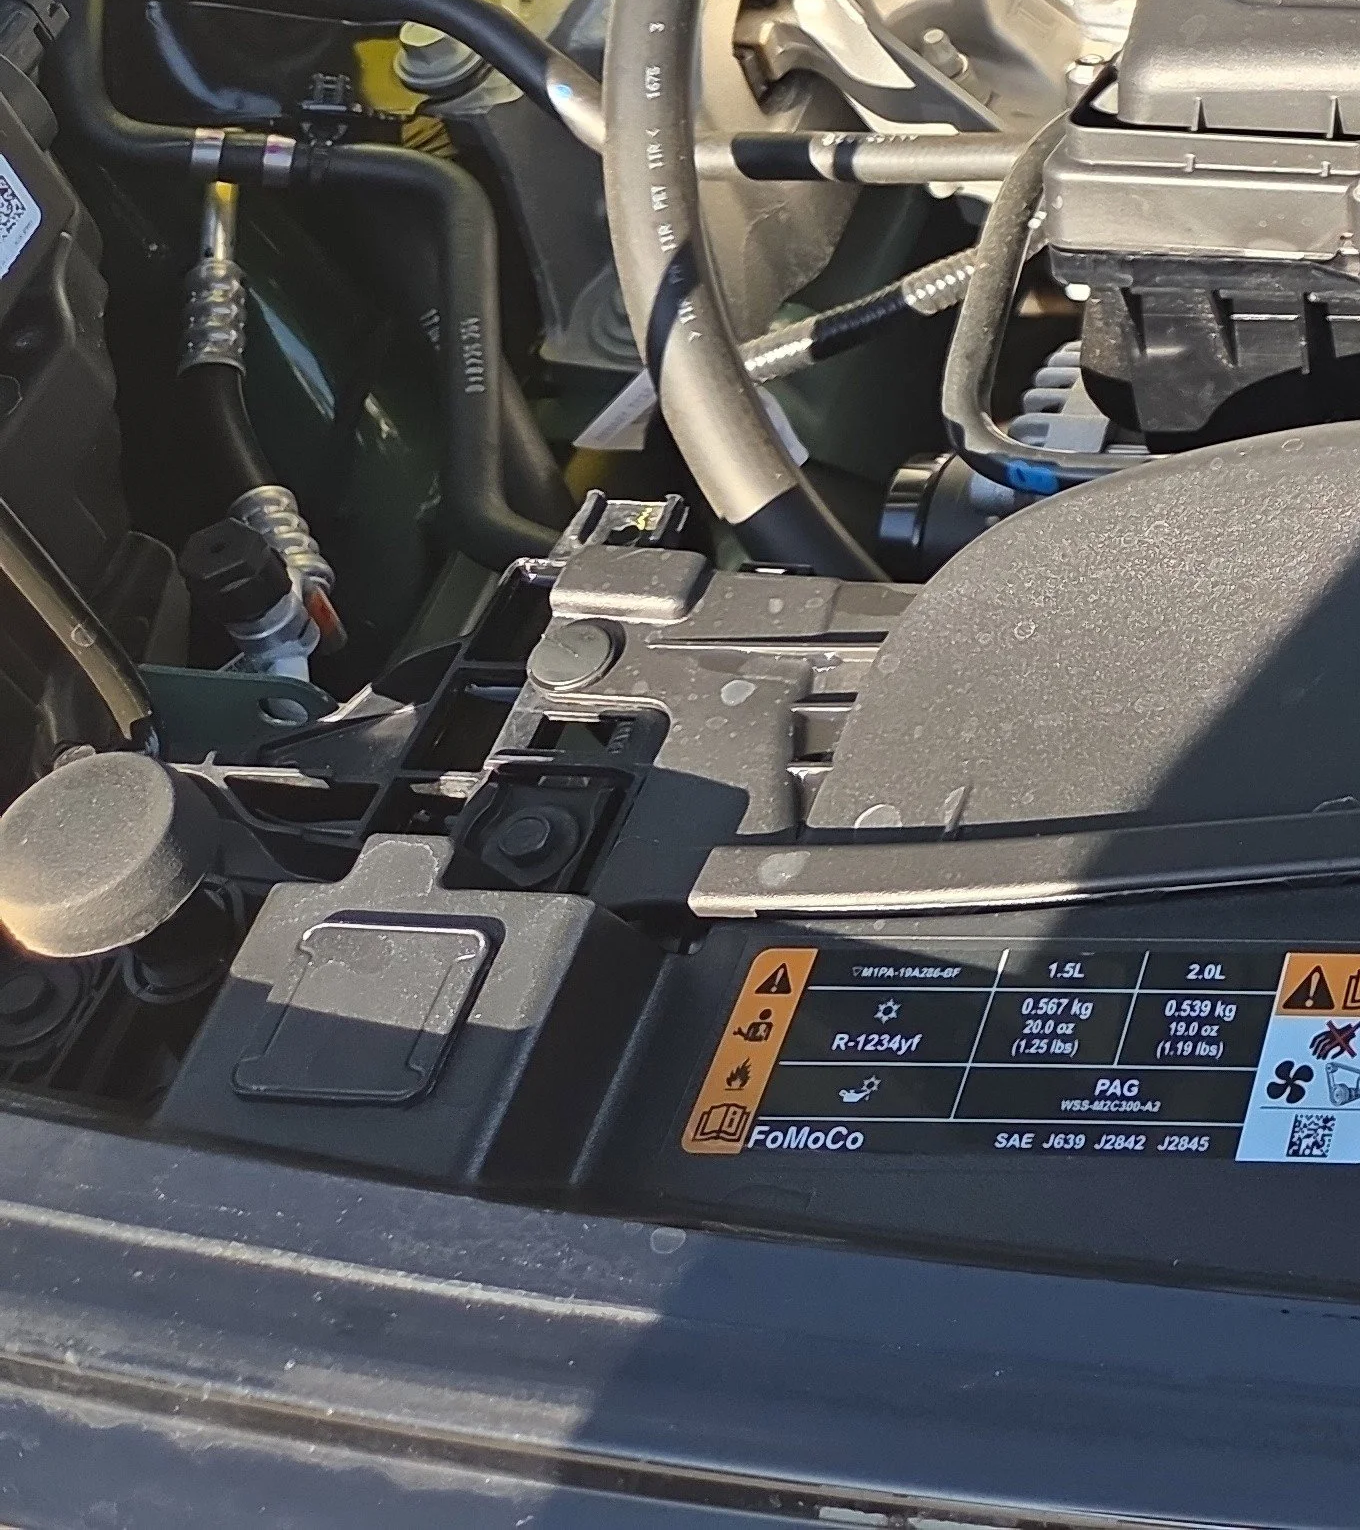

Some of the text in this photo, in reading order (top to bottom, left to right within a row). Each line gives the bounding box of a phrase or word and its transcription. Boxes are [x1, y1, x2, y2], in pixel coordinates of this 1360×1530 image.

[1047, 962, 1085, 978] 1.5L
[1186, 964, 1226, 980] 2.0L
[1021, 998, 1094, 1019] 0.567 kg
[1164, 1000, 1237, 1021] 0.539 kg
[1022, 1019, 1075, 1034] 20.0 oz
[1168, 1021, 1219, 1037] 19.0 oz
[831, 1033, 923, 1055] R-1234yf
[1011, 1039, 1079, 1057] (1.25 lbs)
[1156, 1041, 1224, 1059] (1.19 lbs)
[1094, 1078, 1140, 1096] PAG
[747, 1125, 865, 1150] FoMoCo
[994, 1133, 1210, 1151] SAE J639 J2842 J2845
